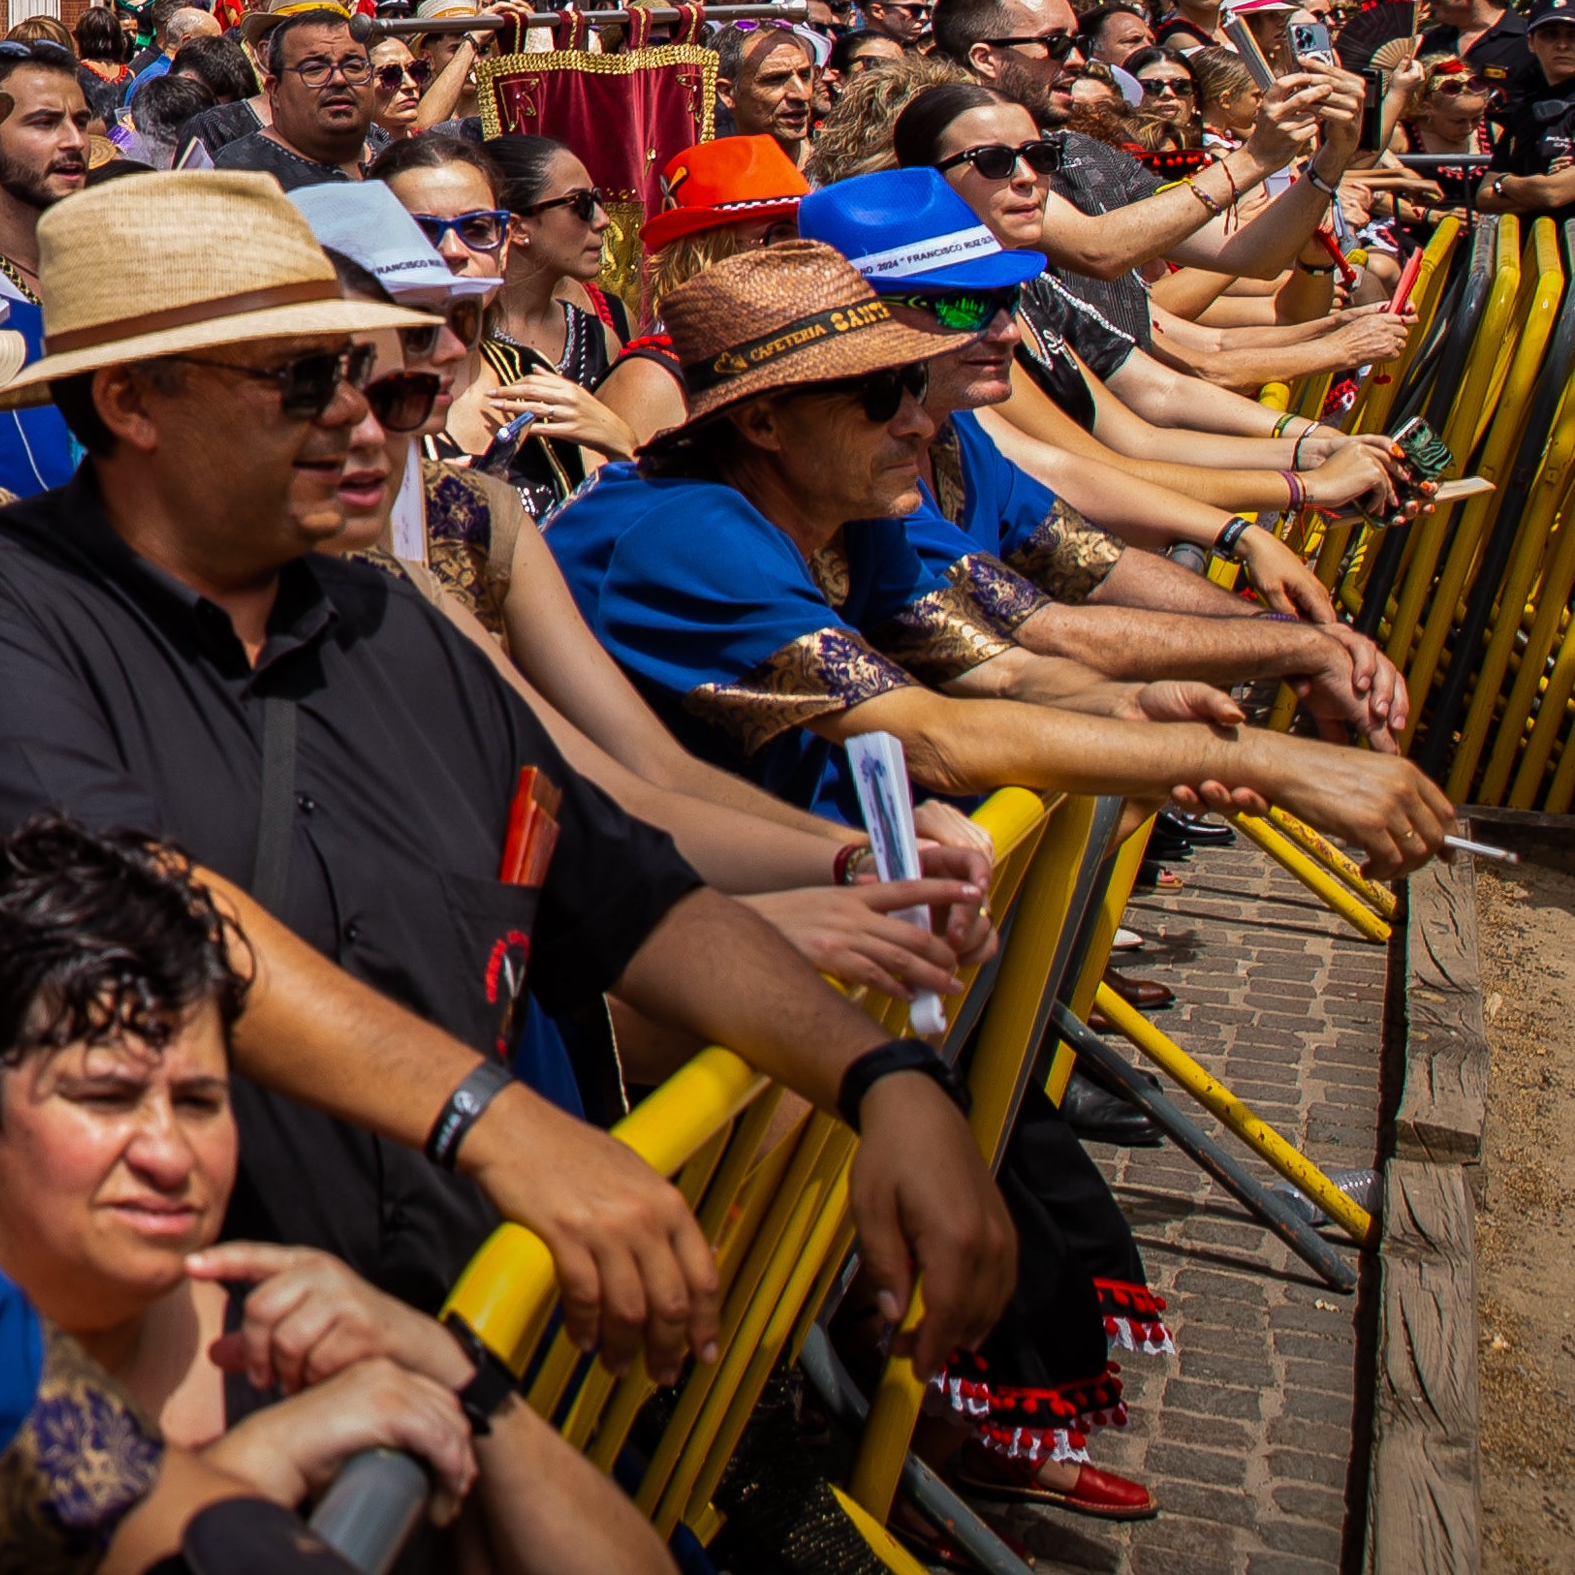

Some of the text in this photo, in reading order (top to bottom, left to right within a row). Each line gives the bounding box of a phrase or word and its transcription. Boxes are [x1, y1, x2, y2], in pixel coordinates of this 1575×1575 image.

[877, 258, 898, 273] 2024
[907, 243, 963, 264] FRANCISCO
[751, 323, 827, 362] CAFETERIA
